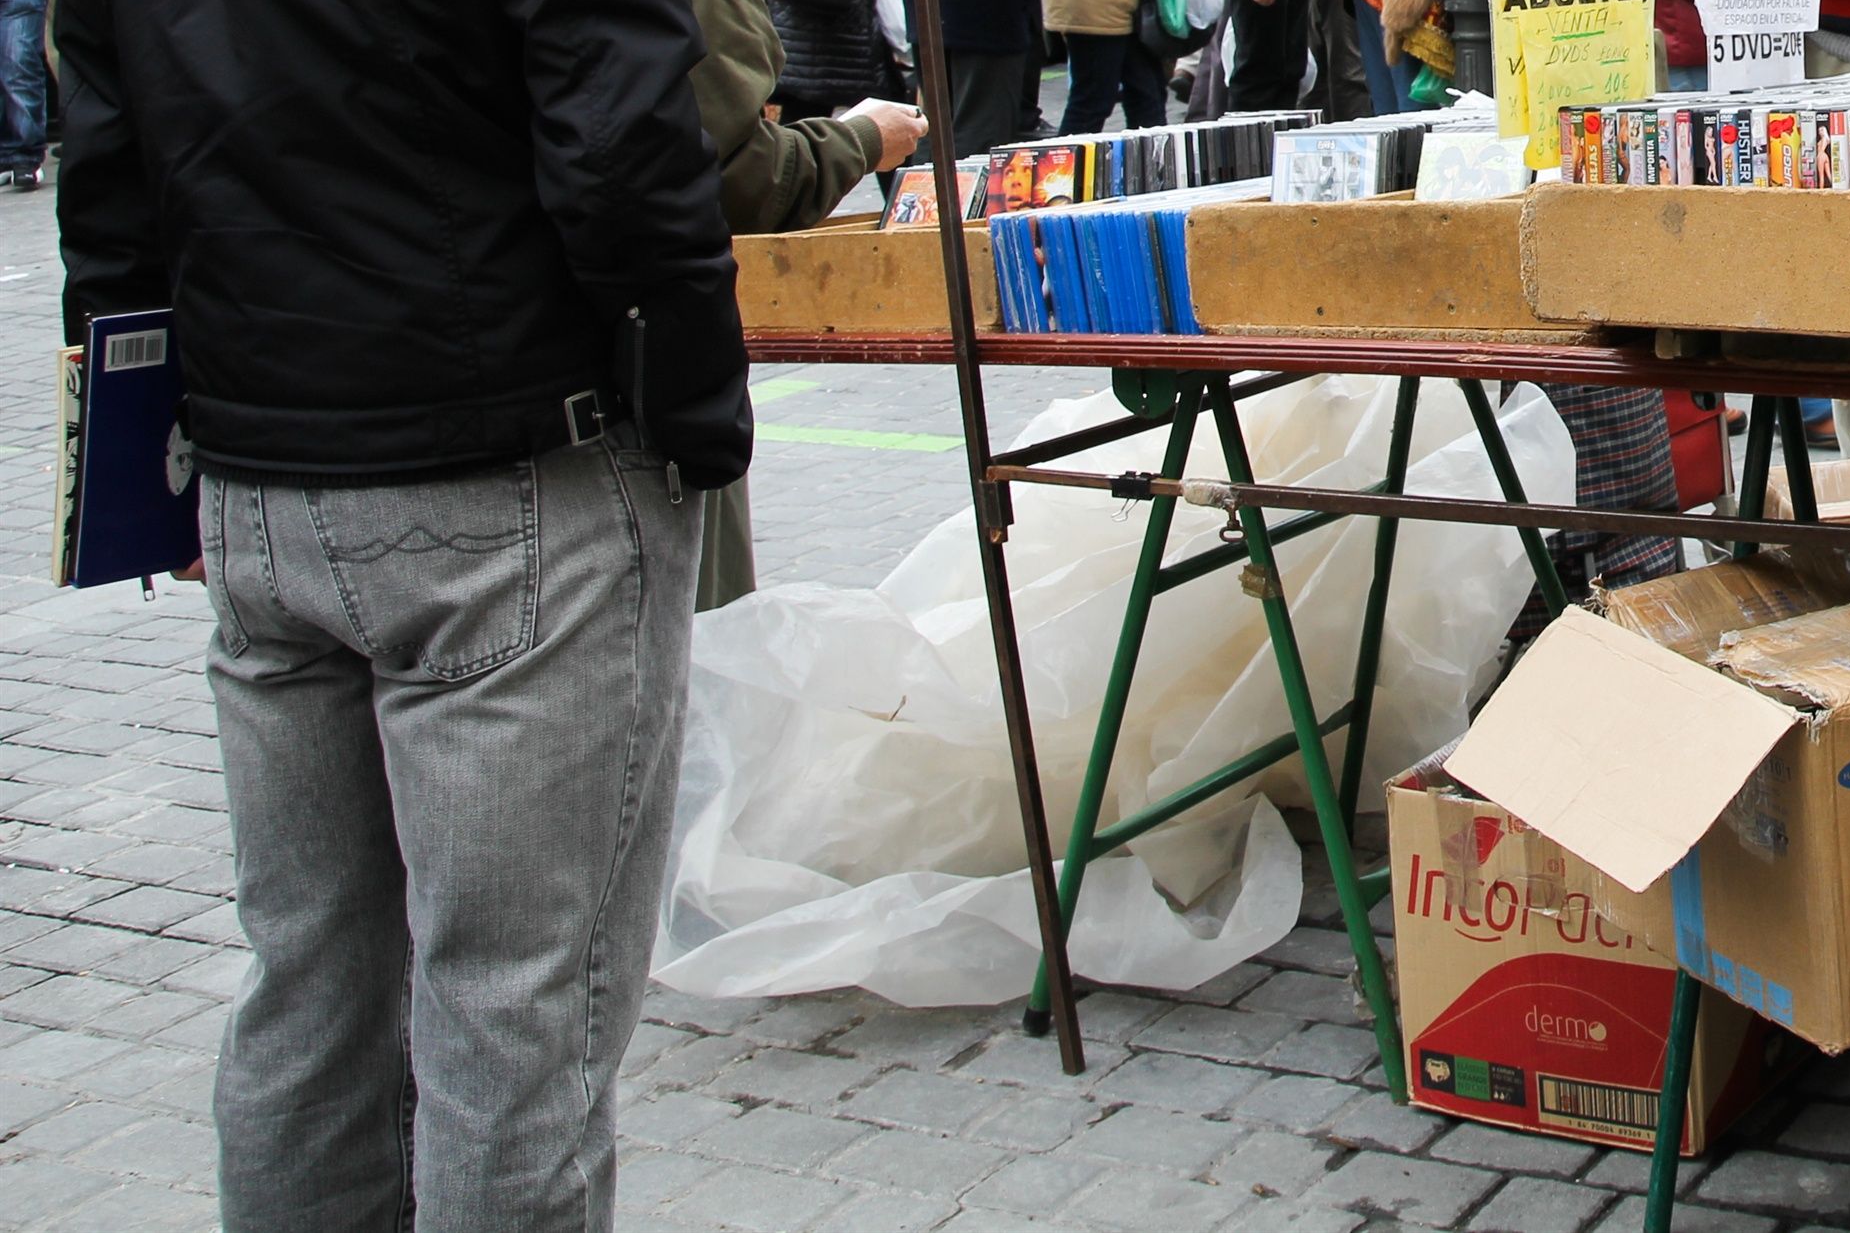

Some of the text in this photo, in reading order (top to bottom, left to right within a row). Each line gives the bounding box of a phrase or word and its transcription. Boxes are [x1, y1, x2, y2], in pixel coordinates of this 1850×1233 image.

[1547, 8, 1609, 33] VENTA
[1724, 13, 1758, 26] ESPACIO
[1714, 35, 1724, 62] 5
[1646, 139, 1655, 183] IMPORTA
[1738, 120, 1752, 180] HUSTLER
[1525, 1005, 1607, 1042] dermo
